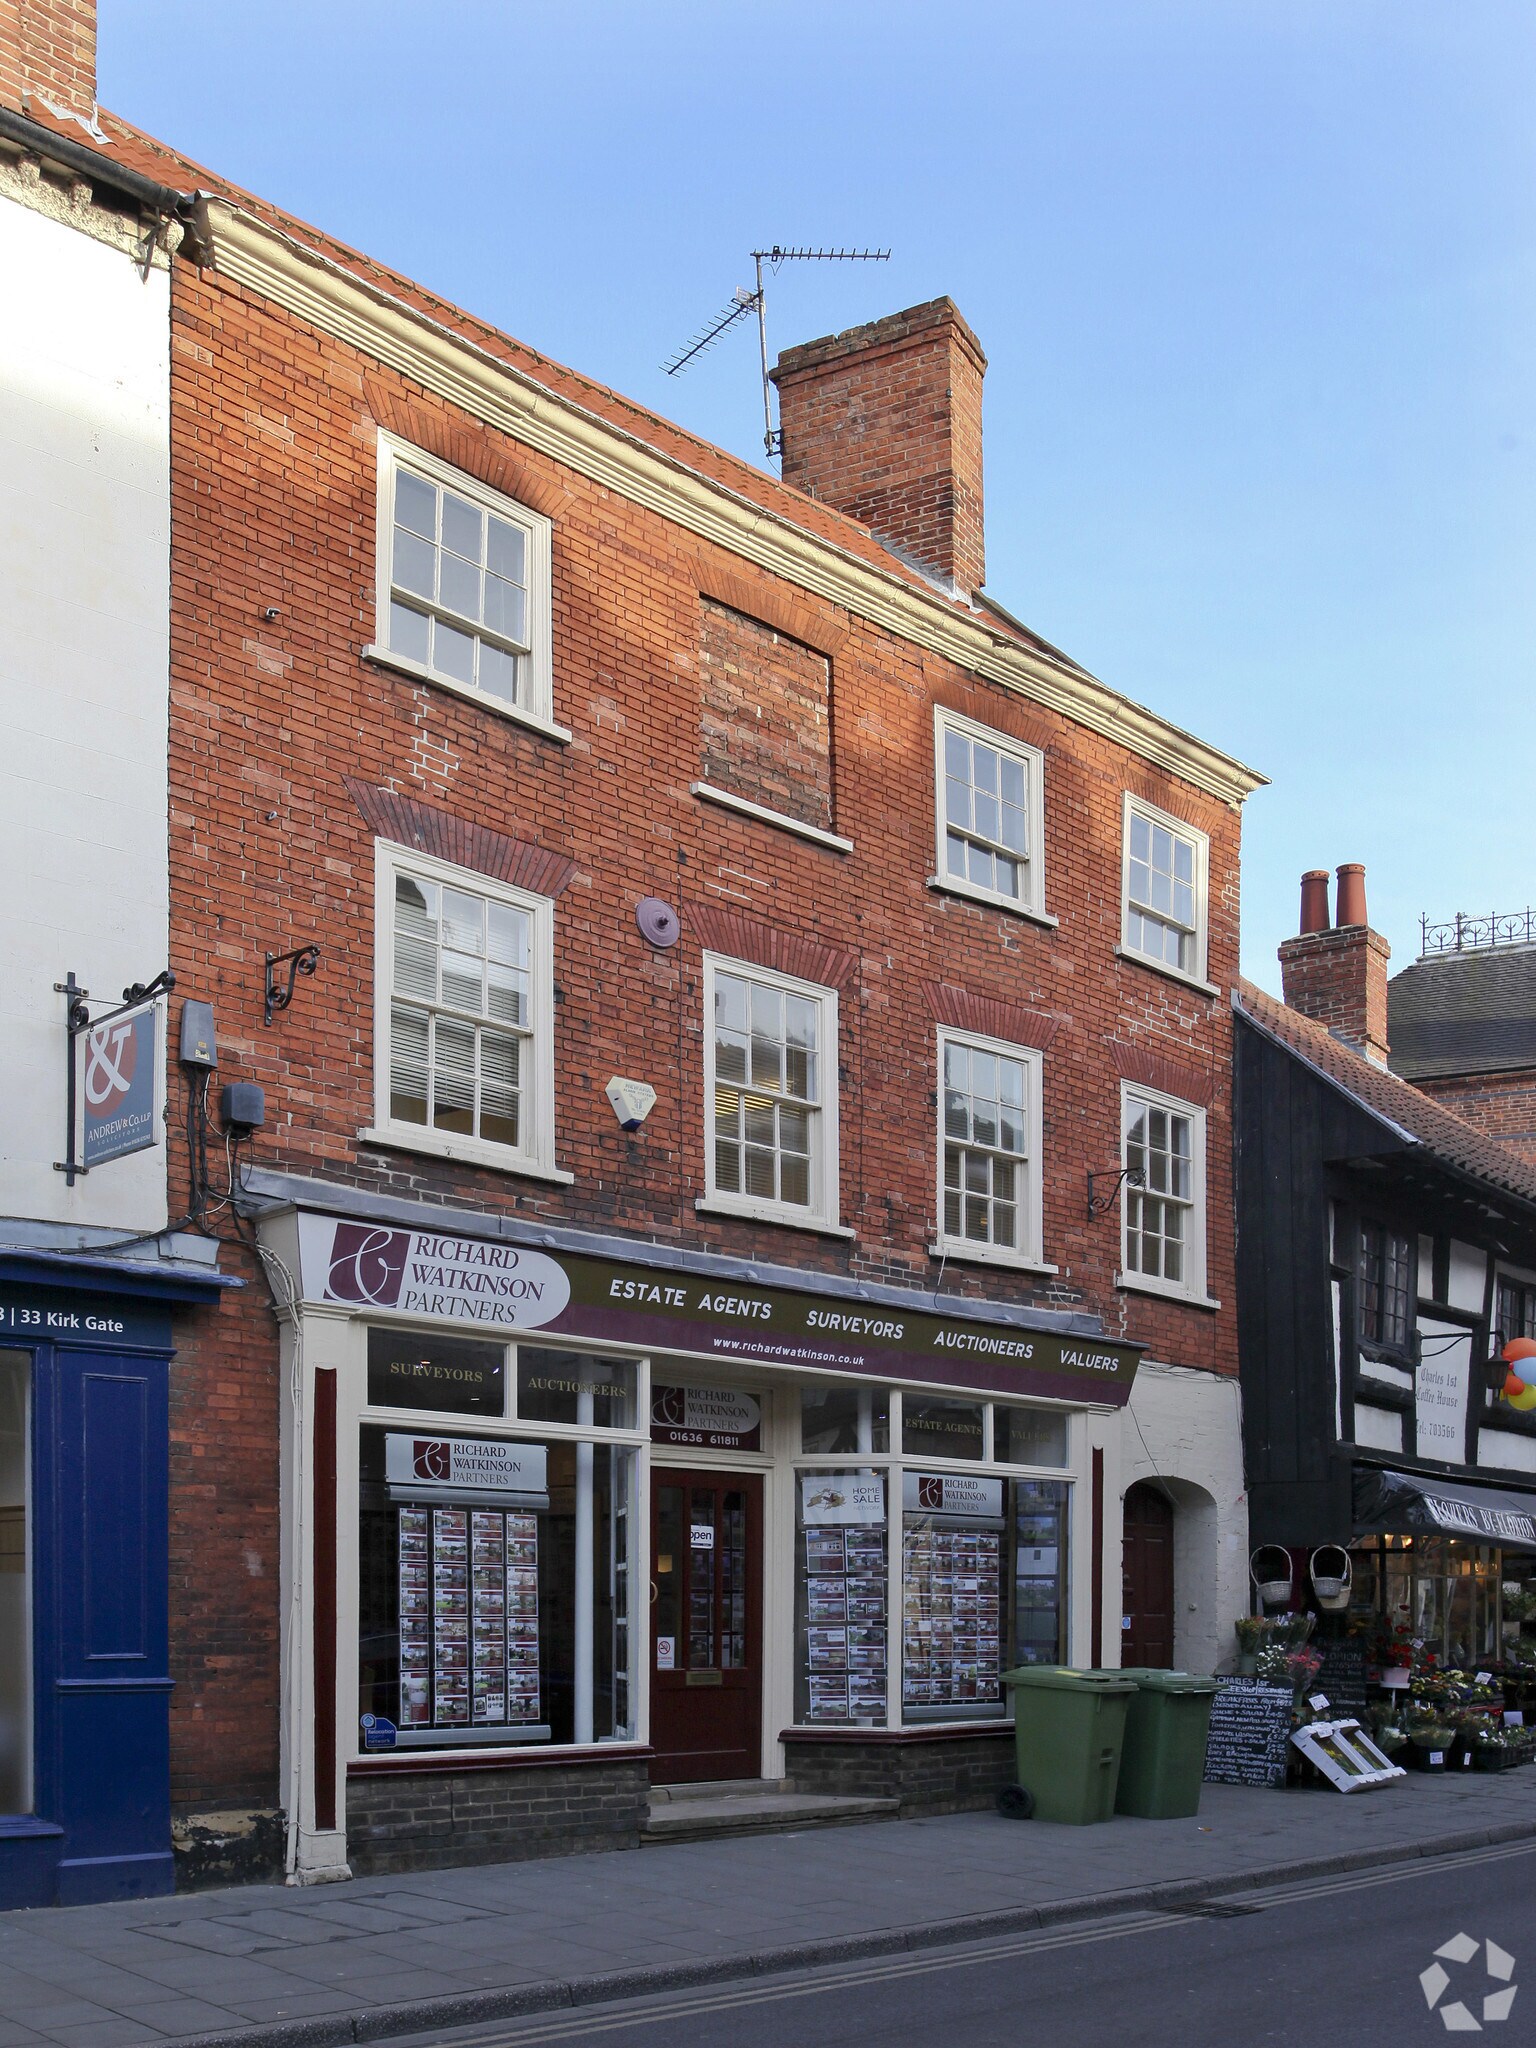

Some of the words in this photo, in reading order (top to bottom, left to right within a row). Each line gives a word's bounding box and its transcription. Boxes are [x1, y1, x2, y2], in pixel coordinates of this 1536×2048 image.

[414, 1235, 519, 1270] RICHARD
[411, 1263, 546, 1302] WATKINSON
[403, 1290, 517, 1323] PARTNERS
[20, 1309, 41, 1325] 33
[47, 1312, 80, 1328] Kirk
[85, 1316, 124, 1333] Gate
[609, 1279, 687, 1307] ESTATE
[698, 1293, 773, 1320] AGENTS
[806, 1309, 904, 1340] SURVEYORS
[933, 1330, 1034, 1359] AUCTIONEERS
[1059, 1349, 1119, 1372] VALUERS
[713, 1338, 865, 1366] www.richardwatkinson.co.uk
[390, 1362, 484, 1383] SURVEYORS
[1420, 1368, 1444, 1385] Charles
[528, 1377, 627, 1398] AUCTIONEERS
[687, 1388, 735, 1402] RICHARD
[1437, 1390, 1458, 1407] House
[687, 1402, 749, 1418] WATKINSON
[687, 1417, 740, 1431] PARTNERS
[905, 1418, 943, 1432] ESTATE
[944, 1422, 983, 1435] AGENTS
[669, 1431, 703, 1443] 01636
[710, 1434, 739, 1446] 611811
[453, 1444, 507, 1458] RICHARD
[453, 1458, 522, 1473] WATKINSON
[452, 1471, 509, 1485] PARTNERS
[944, 1478, 978, 1490] RICHARD
[852, 1486, 880, 1495] HOME
[944, 1490, 987, 1501] WATKINSON
[853, 1494, 881, 1504] SALE
[944, 1501, 980, 1511] PARTNERS
[1216, 1676, 1254, 1686] CHARLES
